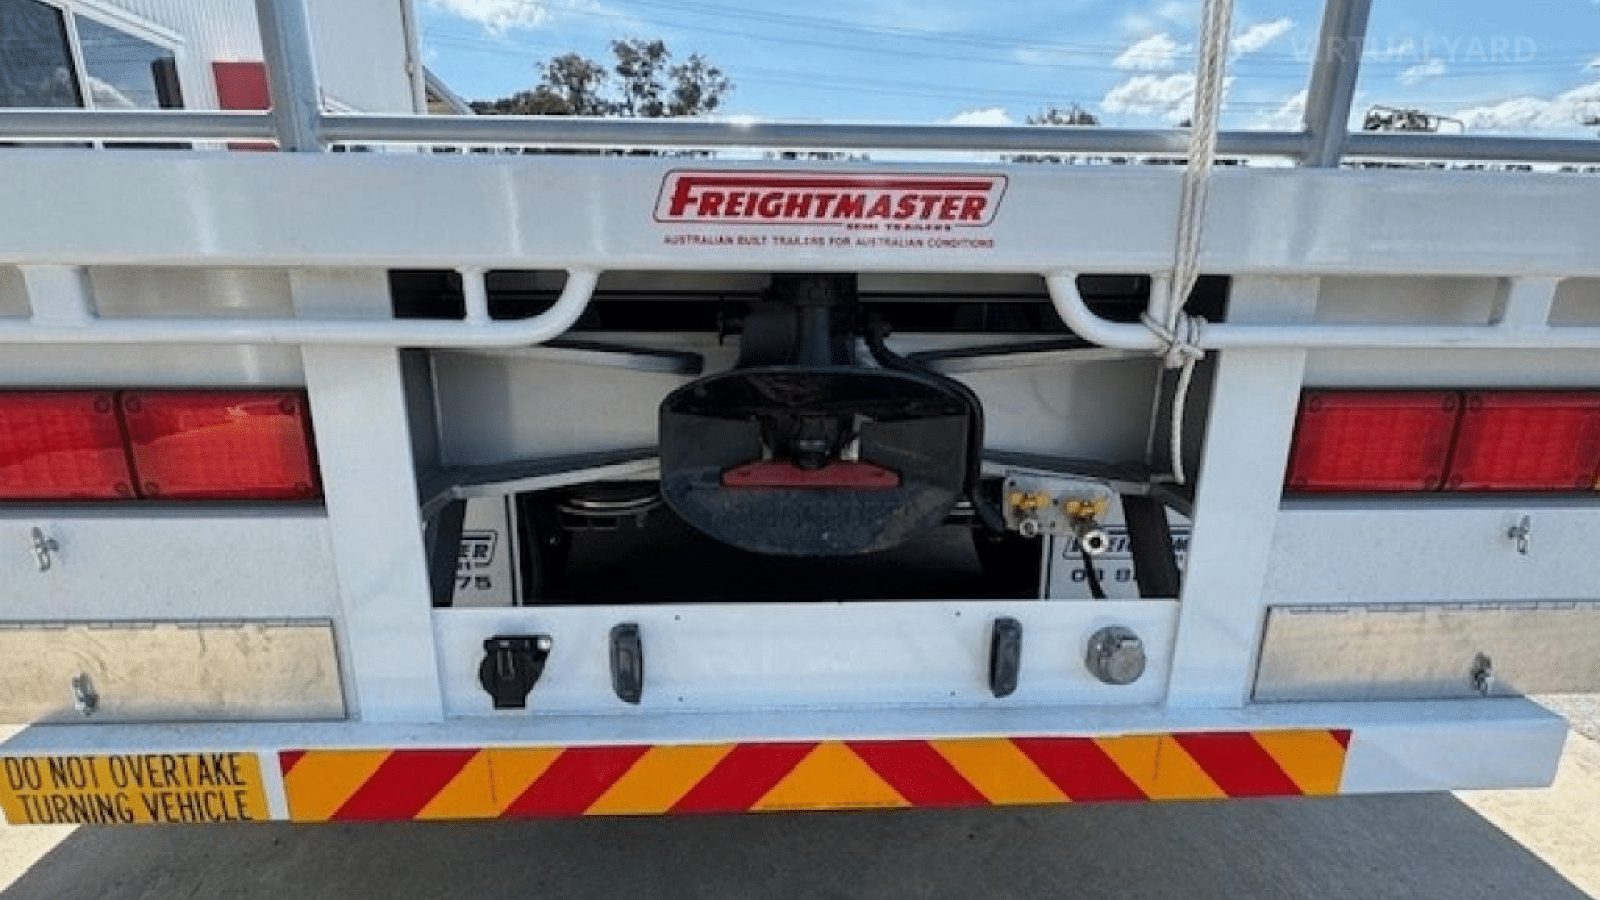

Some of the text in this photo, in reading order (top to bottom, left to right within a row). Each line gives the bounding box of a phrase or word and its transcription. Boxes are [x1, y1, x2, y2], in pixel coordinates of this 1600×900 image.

[669, 176, 993, 221] FREIGHTMASTER
[663, 234, 995, 249] AUSTRALIAN BUILT TRAILERS FOR AUSTRALIAN CONDITIONS
[4, 751, 248, 791] DO NOT OVERTAKE
[16, 788, 254, 825] TURNING VEHICLE
